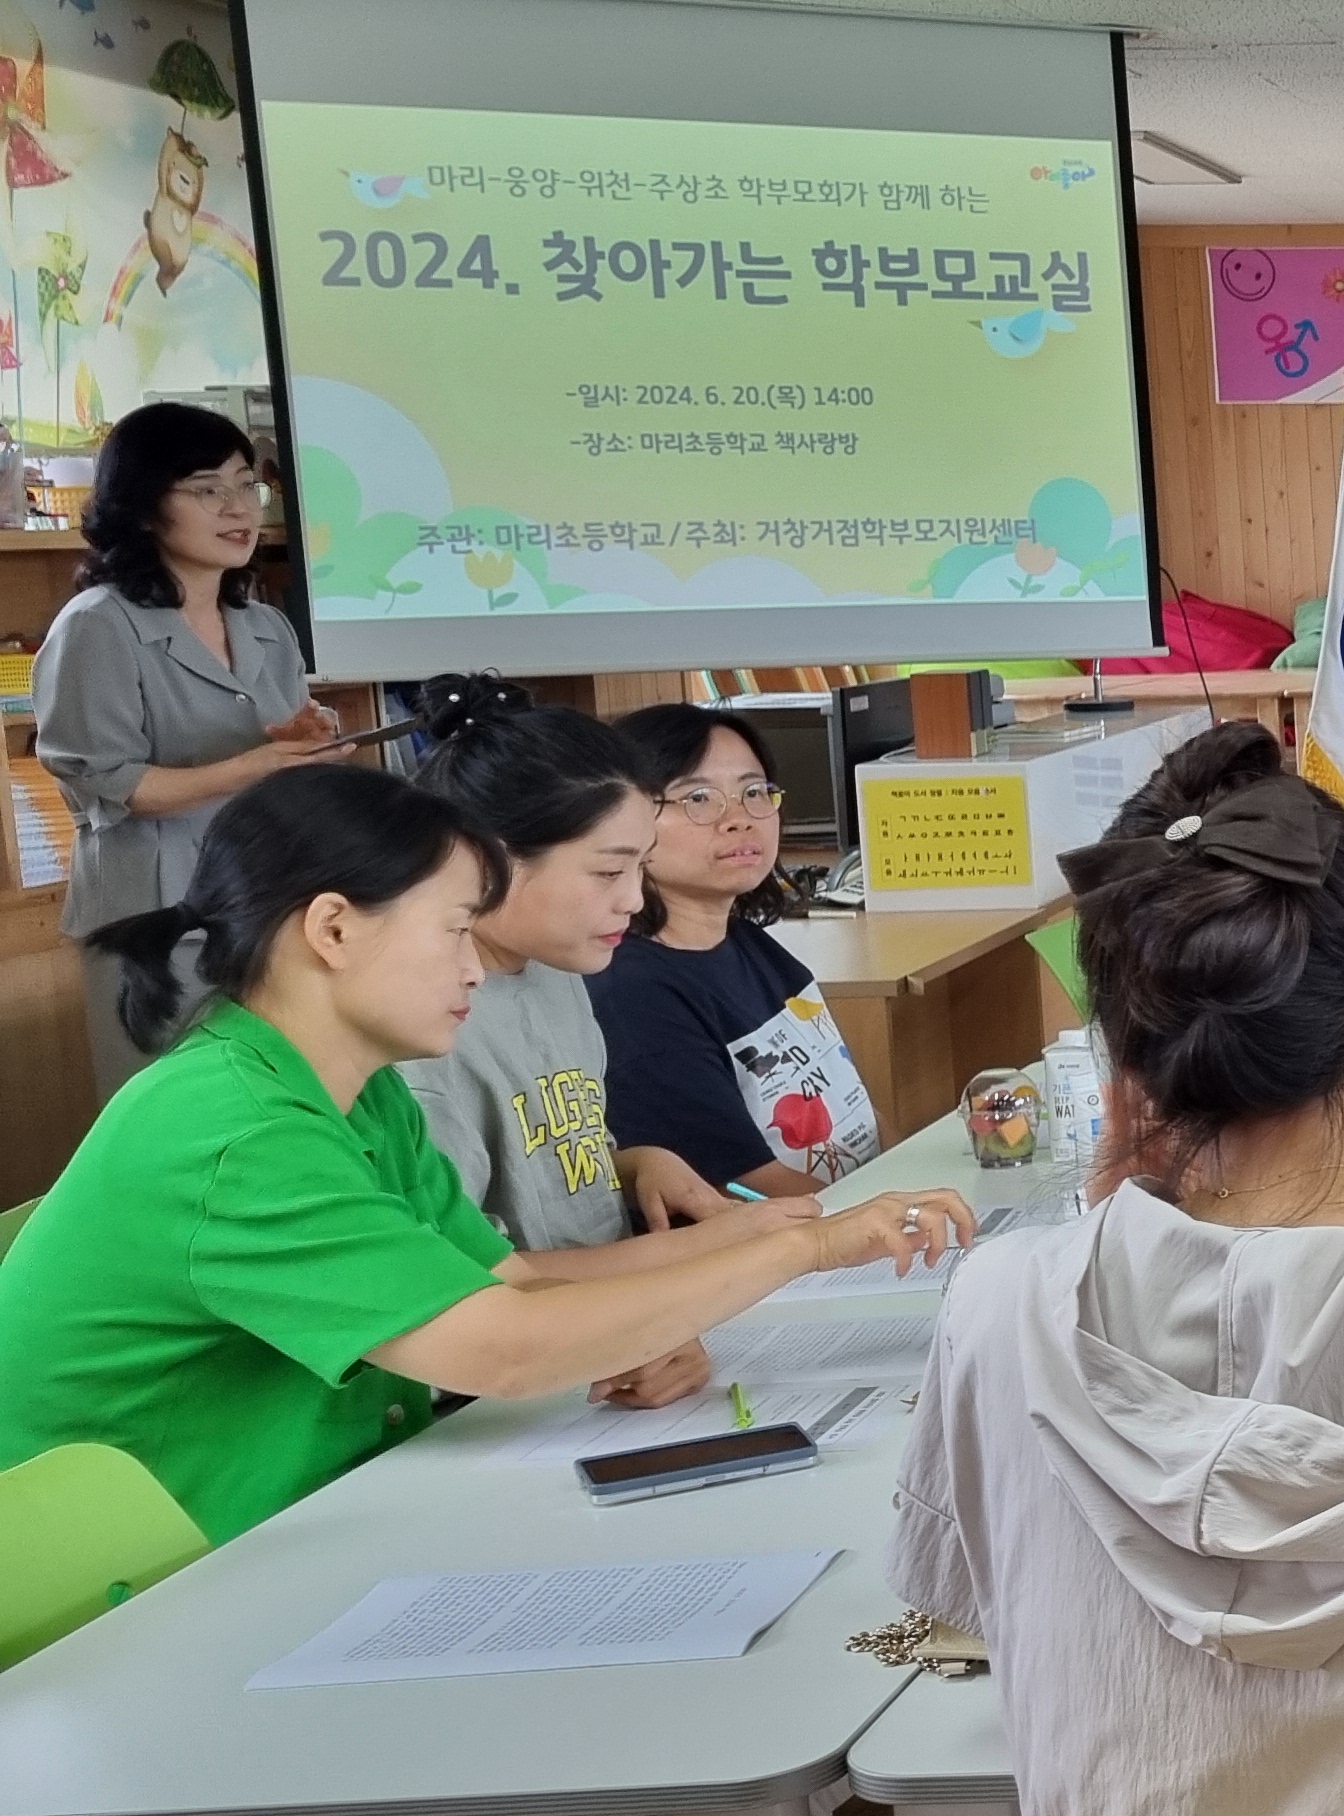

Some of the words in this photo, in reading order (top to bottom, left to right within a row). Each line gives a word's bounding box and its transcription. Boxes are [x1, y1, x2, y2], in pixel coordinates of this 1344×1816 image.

[738, 175, 869, 208] 학부모회가
[878, 180, 930, 211] 함께
[938, 184, 991, 214] 하는
[318, 229, 520, 297] 2024.
[541, 229, 792, 306] 찾아가는
[811, 240, 1093, 313] 학부모교실
[635, 385, 699, 407] 2024.
[705, 385, 726, 407] 6.
[813, 386, 874, 407] 14:00
[640, 432, 769, 456] 마리초등학교
[775, 430, 860, 456] 책사랑방
[416, 523, 485, 554] 주관:
[756, 516, 1037, 550] 거창거점학부모지원센터
